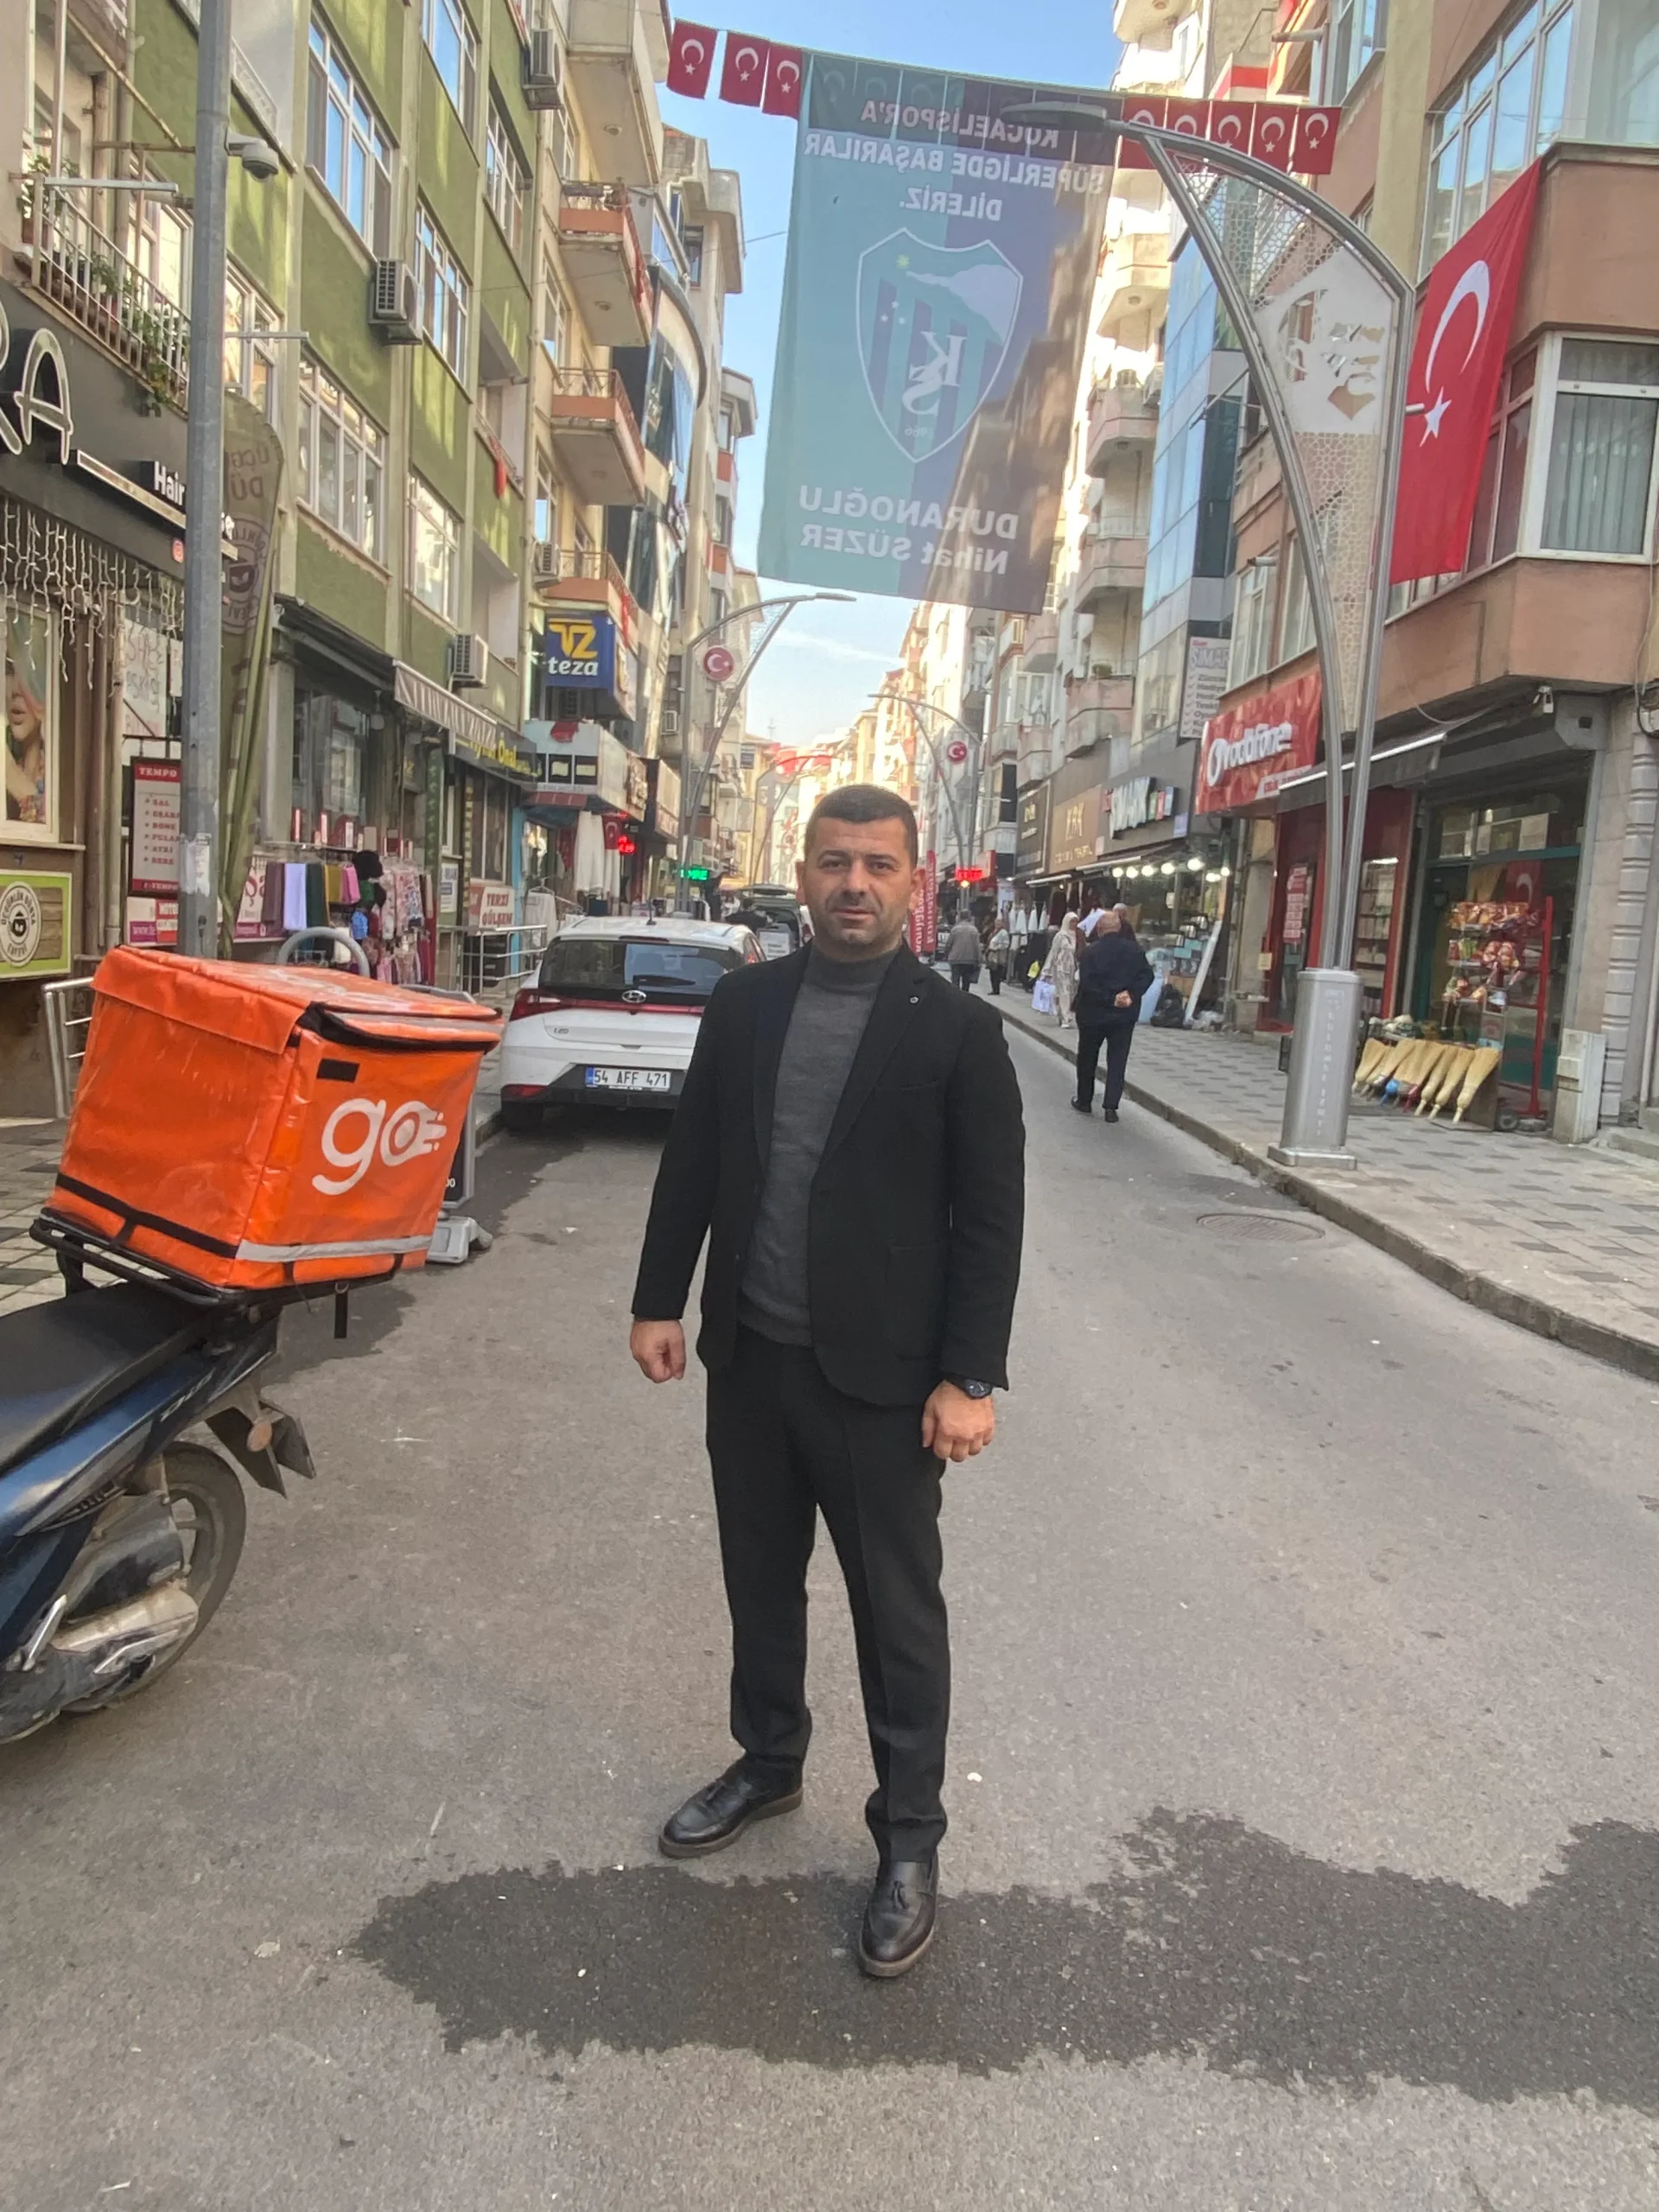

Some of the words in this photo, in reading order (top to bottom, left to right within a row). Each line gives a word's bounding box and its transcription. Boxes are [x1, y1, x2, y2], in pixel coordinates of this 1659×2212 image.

[154, 461, 185, 506] Hair
[548, 658, 599, 676] teza
[139, 767, 177, 777] TEMPO
[594, 1070, 608, 1084] 54
[616, 1071, 639, 1085] AFF
[646, 1072, 668, 1087] 471
